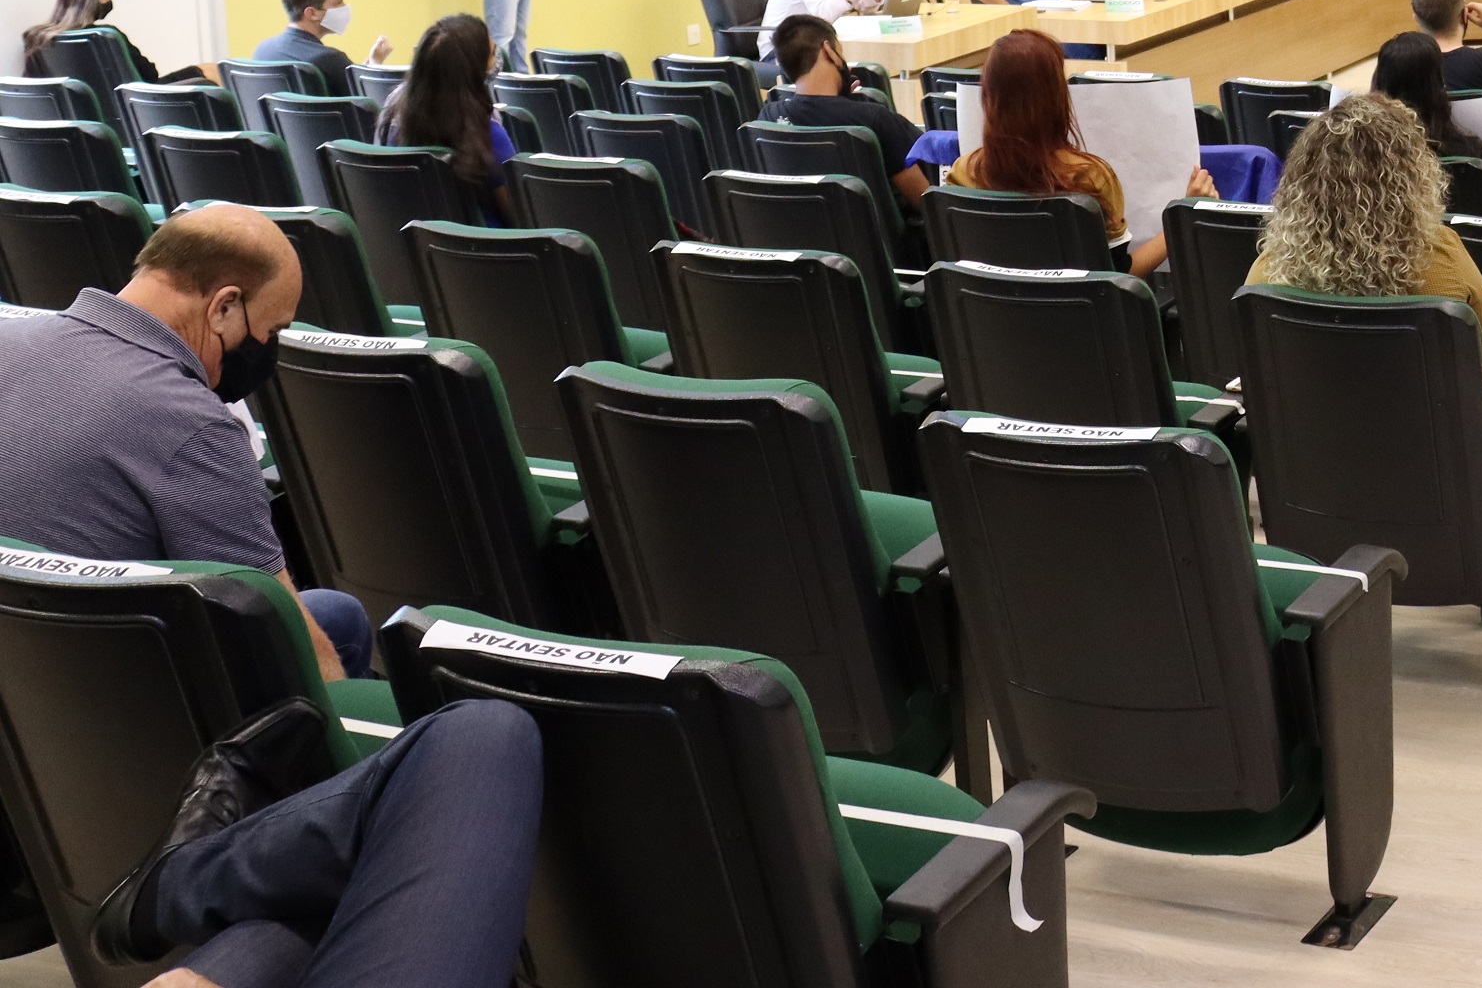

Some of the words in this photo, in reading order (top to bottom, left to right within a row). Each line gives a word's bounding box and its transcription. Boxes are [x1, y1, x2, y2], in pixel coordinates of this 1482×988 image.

[301, 335, 360, 348] SENTAR
[997, 422, 1076, 434] SENTAR
[0, 552, 78, 574] SENTA
[466, 631, 572, 658] SENTAR
[575, 651, 633, 665] NÃO
